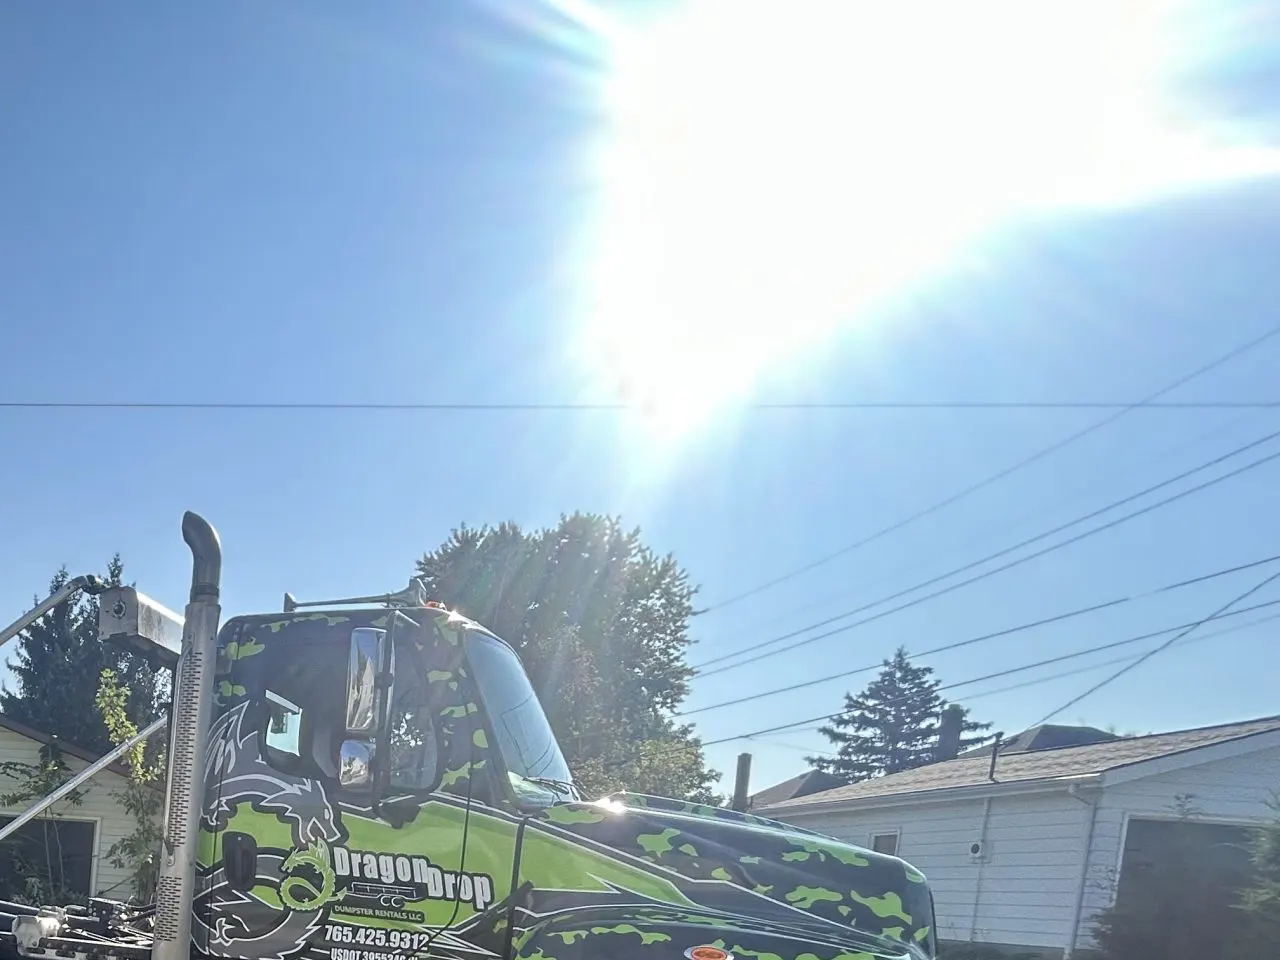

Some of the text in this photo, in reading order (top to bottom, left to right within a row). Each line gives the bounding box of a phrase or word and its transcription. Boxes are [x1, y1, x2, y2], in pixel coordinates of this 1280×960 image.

[333, 847, 492, 910] Dragon Drop
[334, 904, 422, 921] DUMPSTER RENTALS LLC
[325, 924, 430, 951] 765.425.9312
